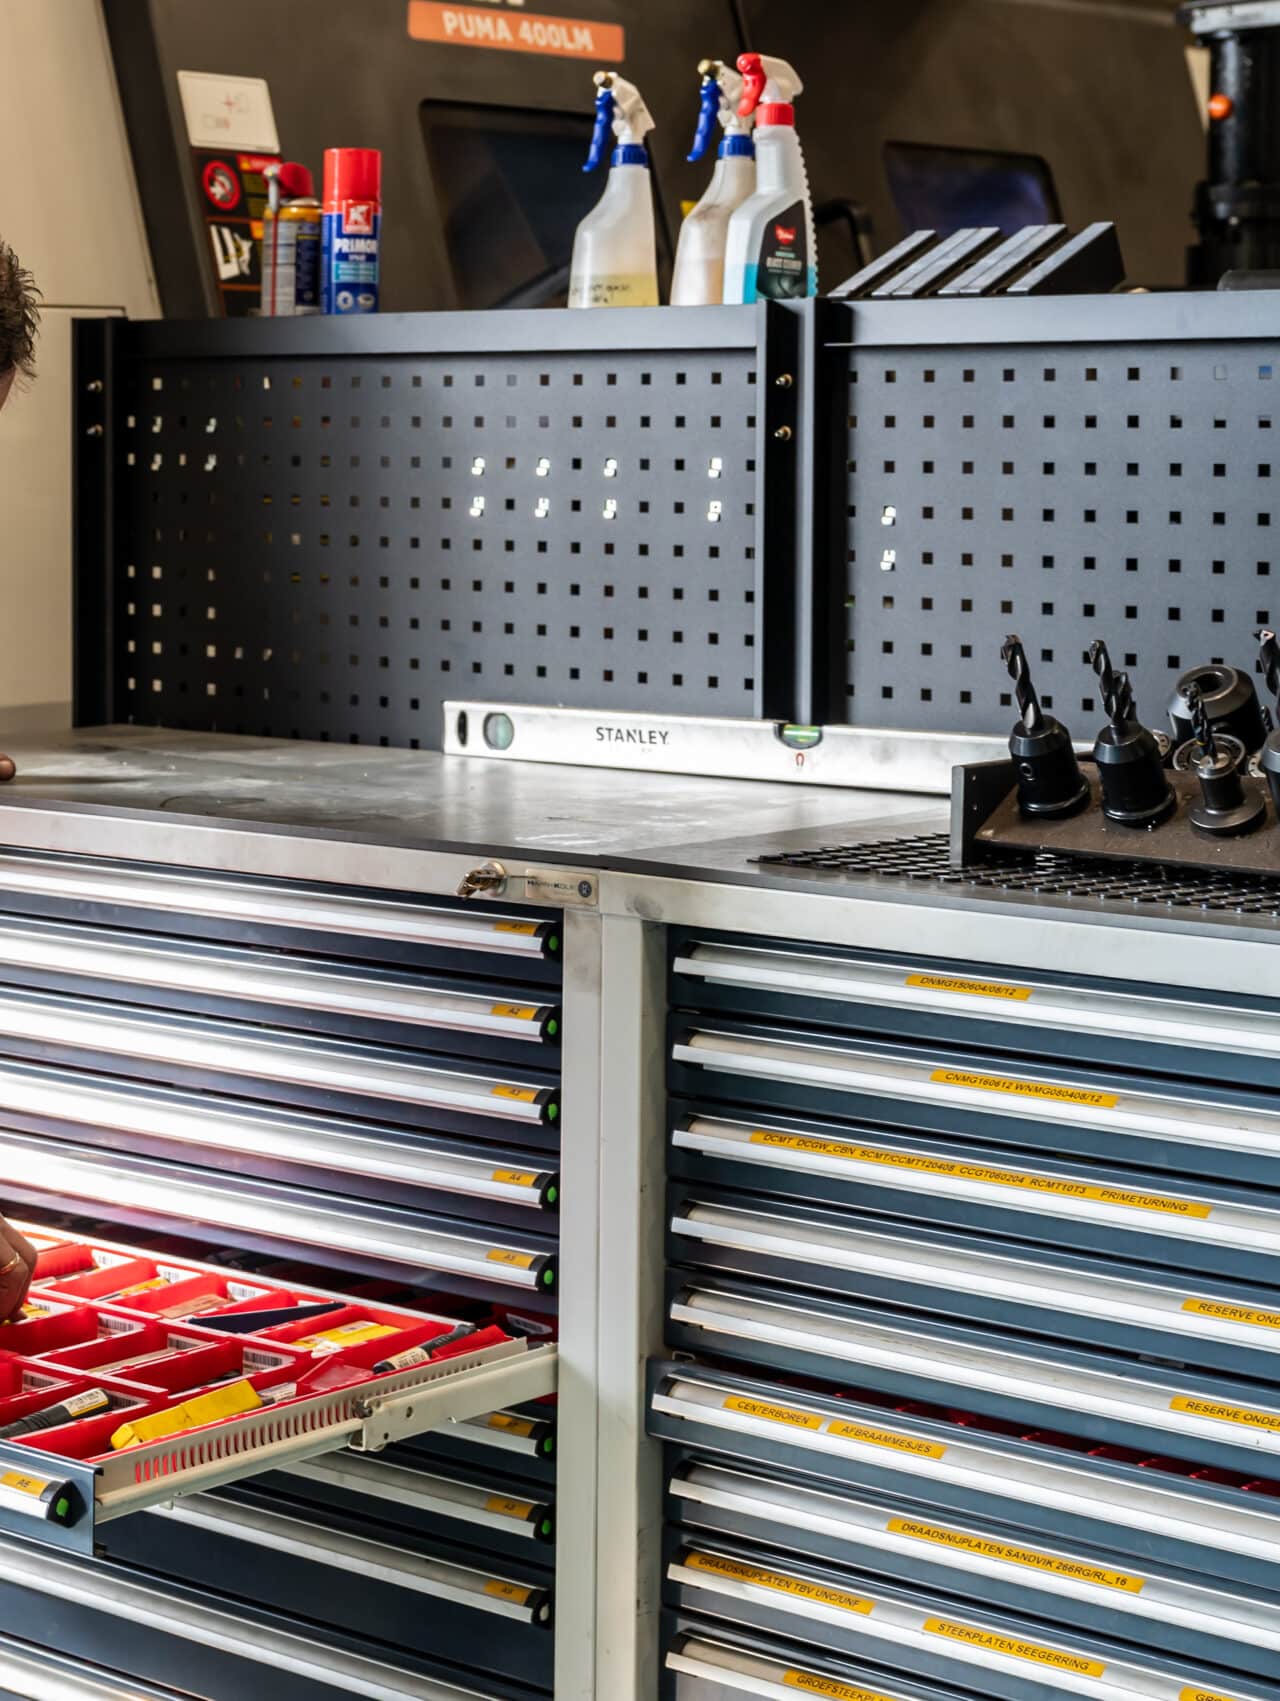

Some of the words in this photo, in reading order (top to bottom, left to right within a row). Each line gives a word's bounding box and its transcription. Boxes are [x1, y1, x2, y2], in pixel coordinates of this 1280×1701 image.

[441, 10, 514, 43] PUMA
[518, 20, 596, 52] 400LM
[596, 726, 668, 745] STANLEY
[944, 1072, 1011, 1090] CNMG160612
[763, 1133, 792, 1145] DCMT
[796, 1139, 856, 1156] DCGW_CBN
[959, 1166, 1025, 1184] CCGT060204
[1030, 1178, 1087, 1194] RCMT10T3
[1100, 1189, 1189, 1212] PRIMETURNING
[1198, 1302, 1254, 1320] RESERVE
[737, 1400, 810, 1425] CENTERBOREN
[1185, 1400, 1241, 1419] RESERVE
[841, 1425, 932, 1454] AFBRAAMMESJES
[901, 1522, 1003, 1555] DRAADSNIJPLATEN
[1005, 1545, 1054, 1568] SANDVIK
[1055, 1560, 1128, 1586] 266RG/RL_16
[698, 1557, 795, 1588] DRAADSNIJPLATEN
[794, 1583, 815, 1595] TBV
[815, 1588, 861, 1607] UNC/UNF
[938, 1622, 1015, 1651] STEEKPLATEN
[1015, 1644, 1090, 1671] SEEGERRING
